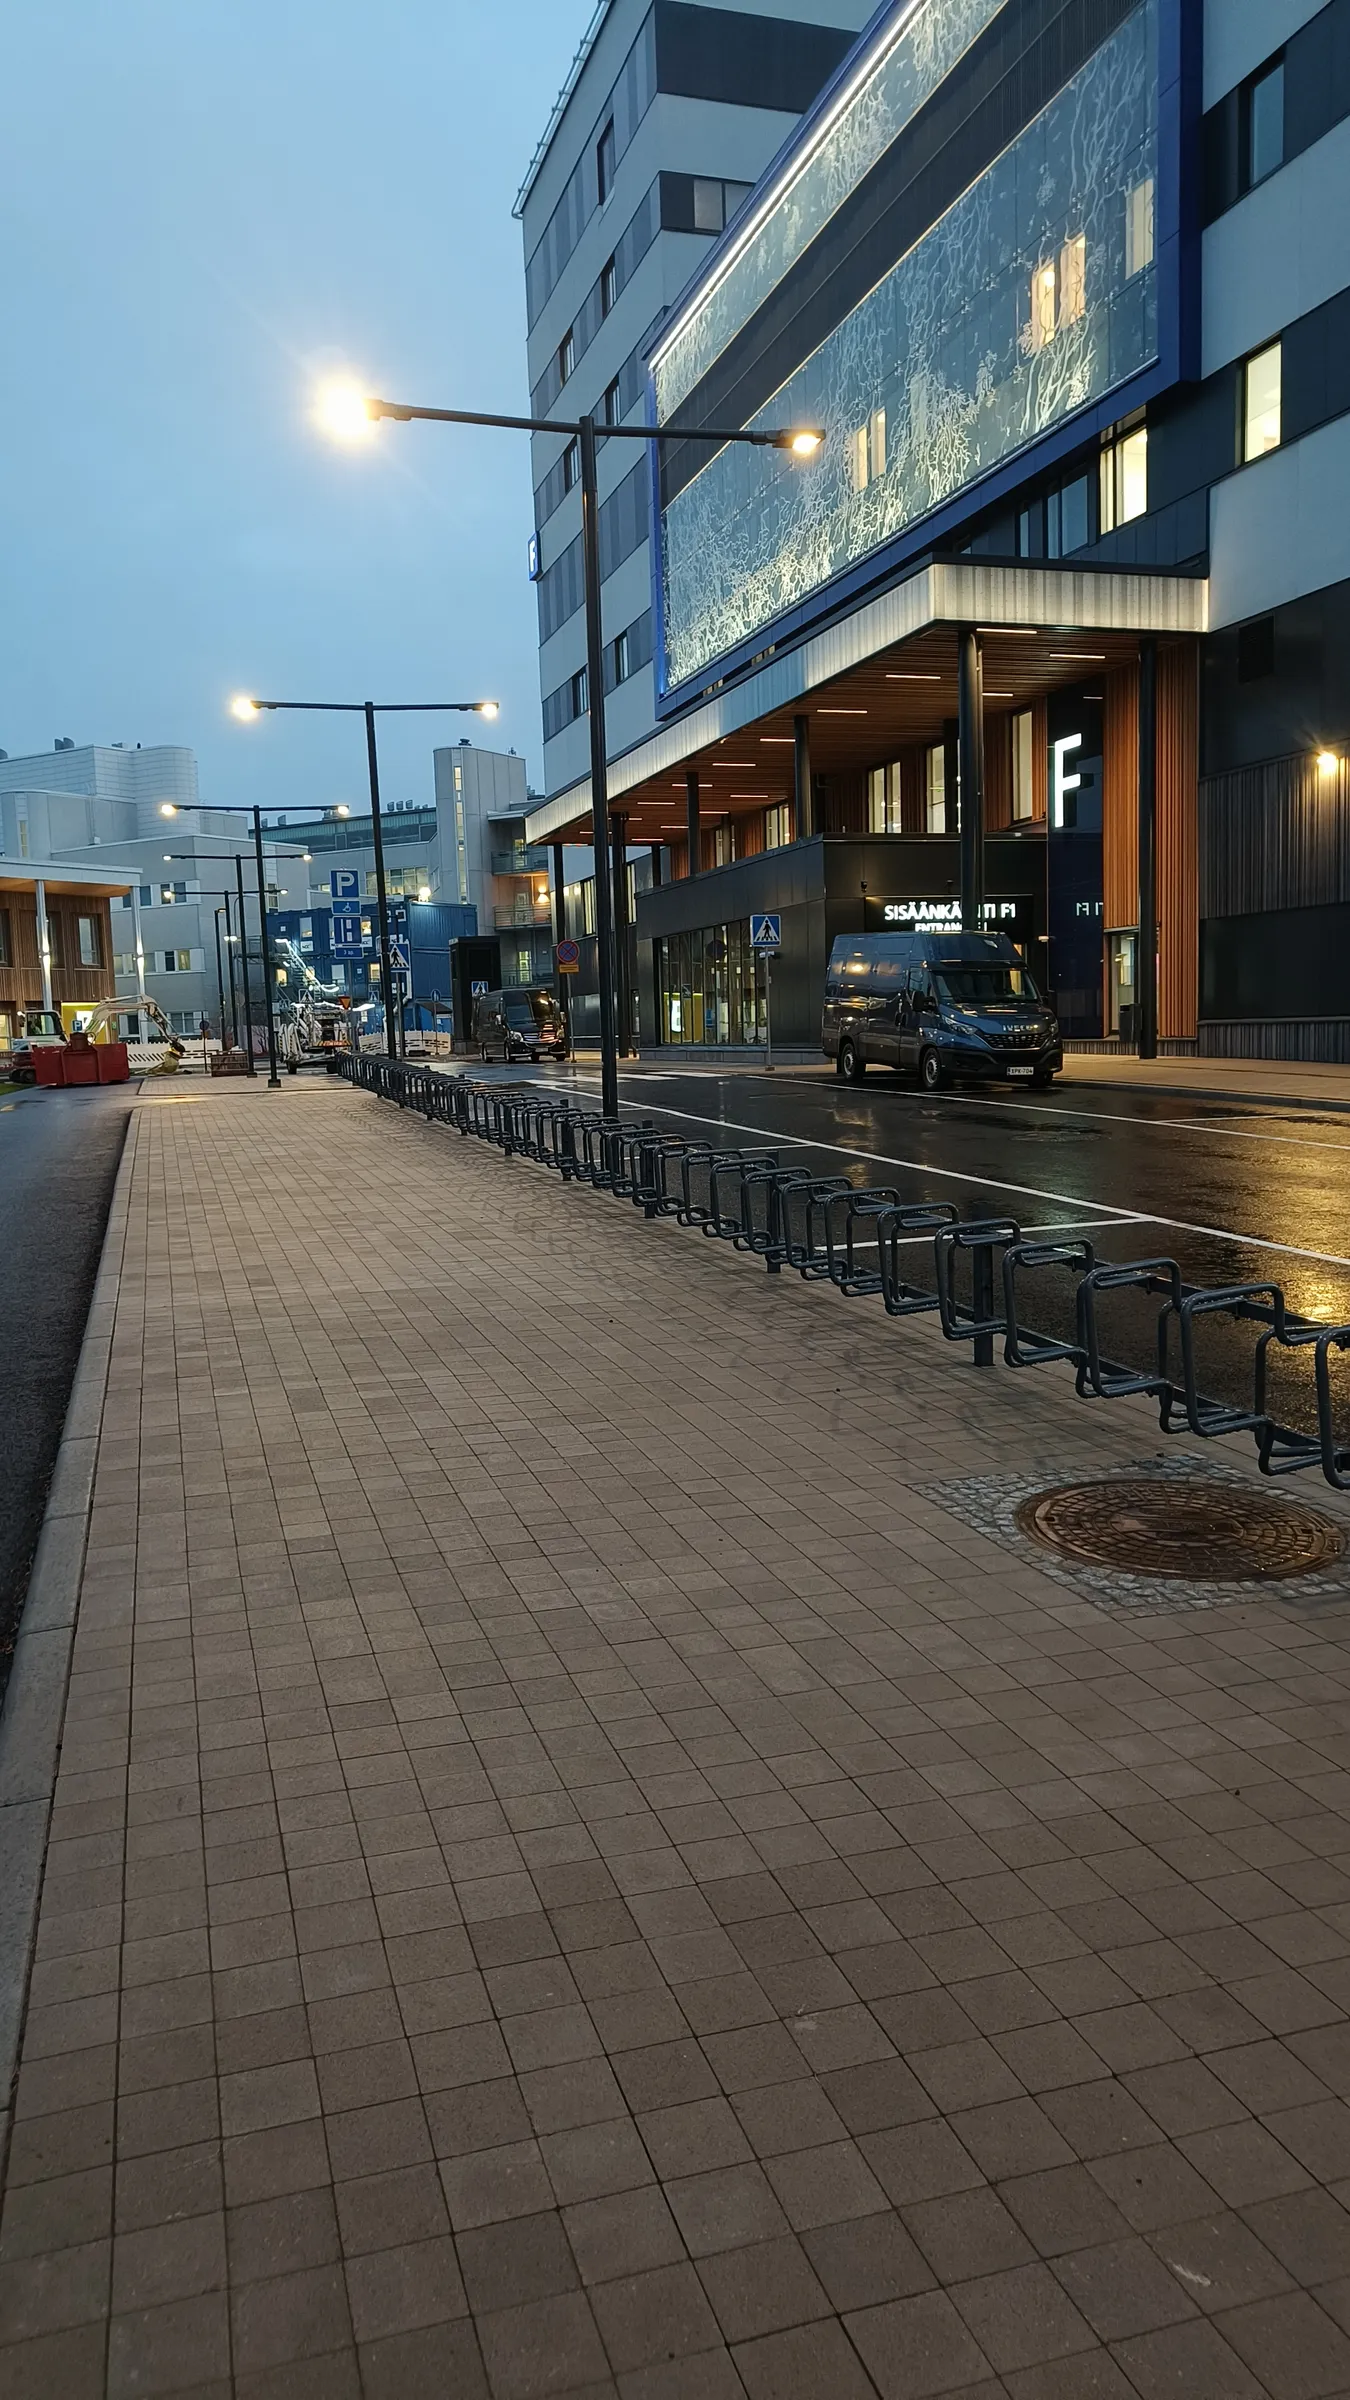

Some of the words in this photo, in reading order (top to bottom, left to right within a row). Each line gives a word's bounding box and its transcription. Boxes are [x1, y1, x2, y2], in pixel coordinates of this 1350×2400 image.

[530, 540, 536, 571] F
[1055, 732, 1082, 828] F
[336, 872, 355, 896] P
[1000, 903, 1016, 919] F1
[75, 1021, 81, 1030] P
